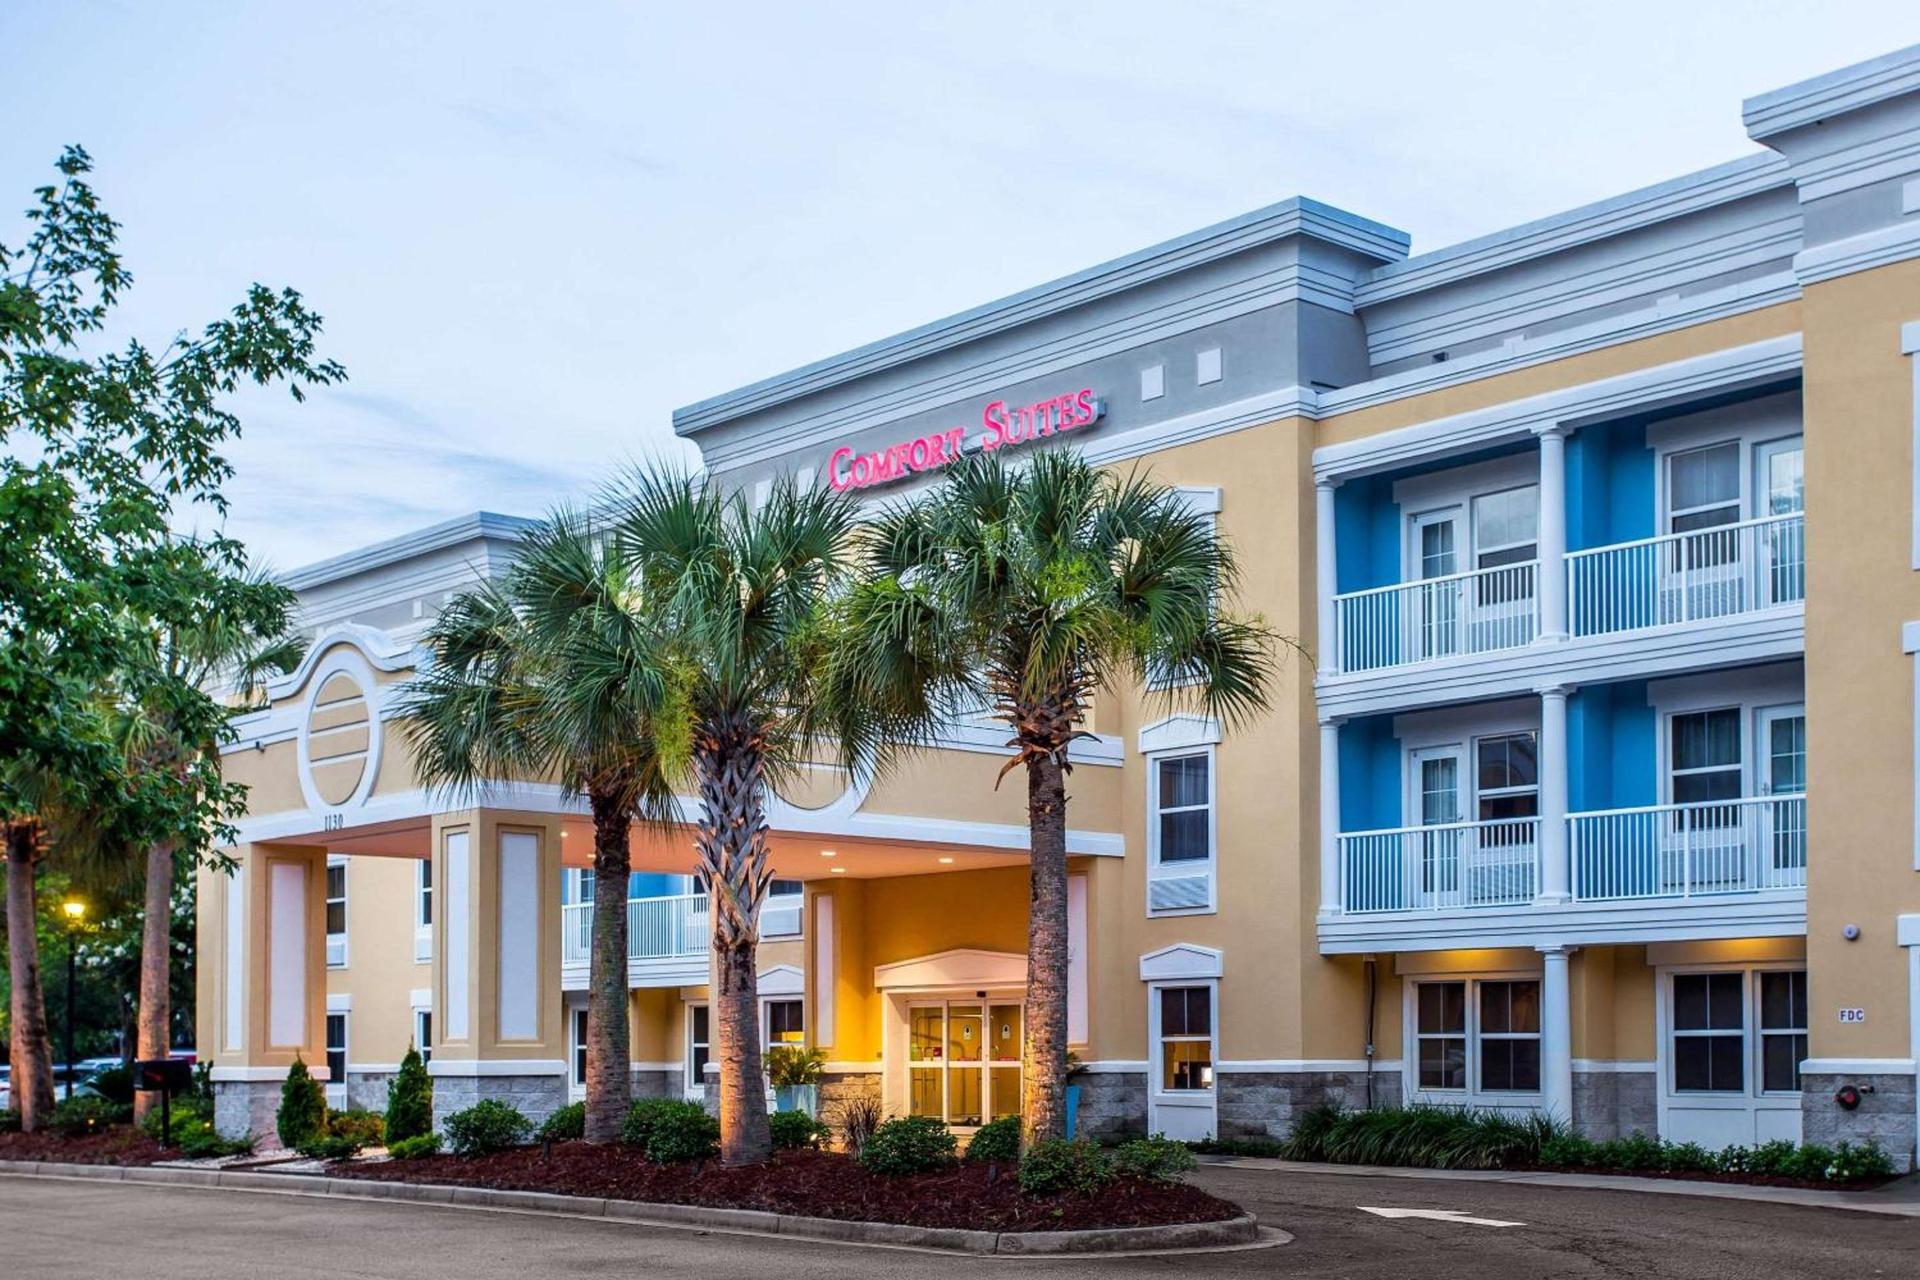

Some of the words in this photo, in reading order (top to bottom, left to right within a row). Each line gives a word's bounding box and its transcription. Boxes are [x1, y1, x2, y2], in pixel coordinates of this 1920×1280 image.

[828, 428, 965, 492] COMFORT
[982, 387, 1094, 451] SUITES
[1840, 1009, 1864, 1021] FDC
